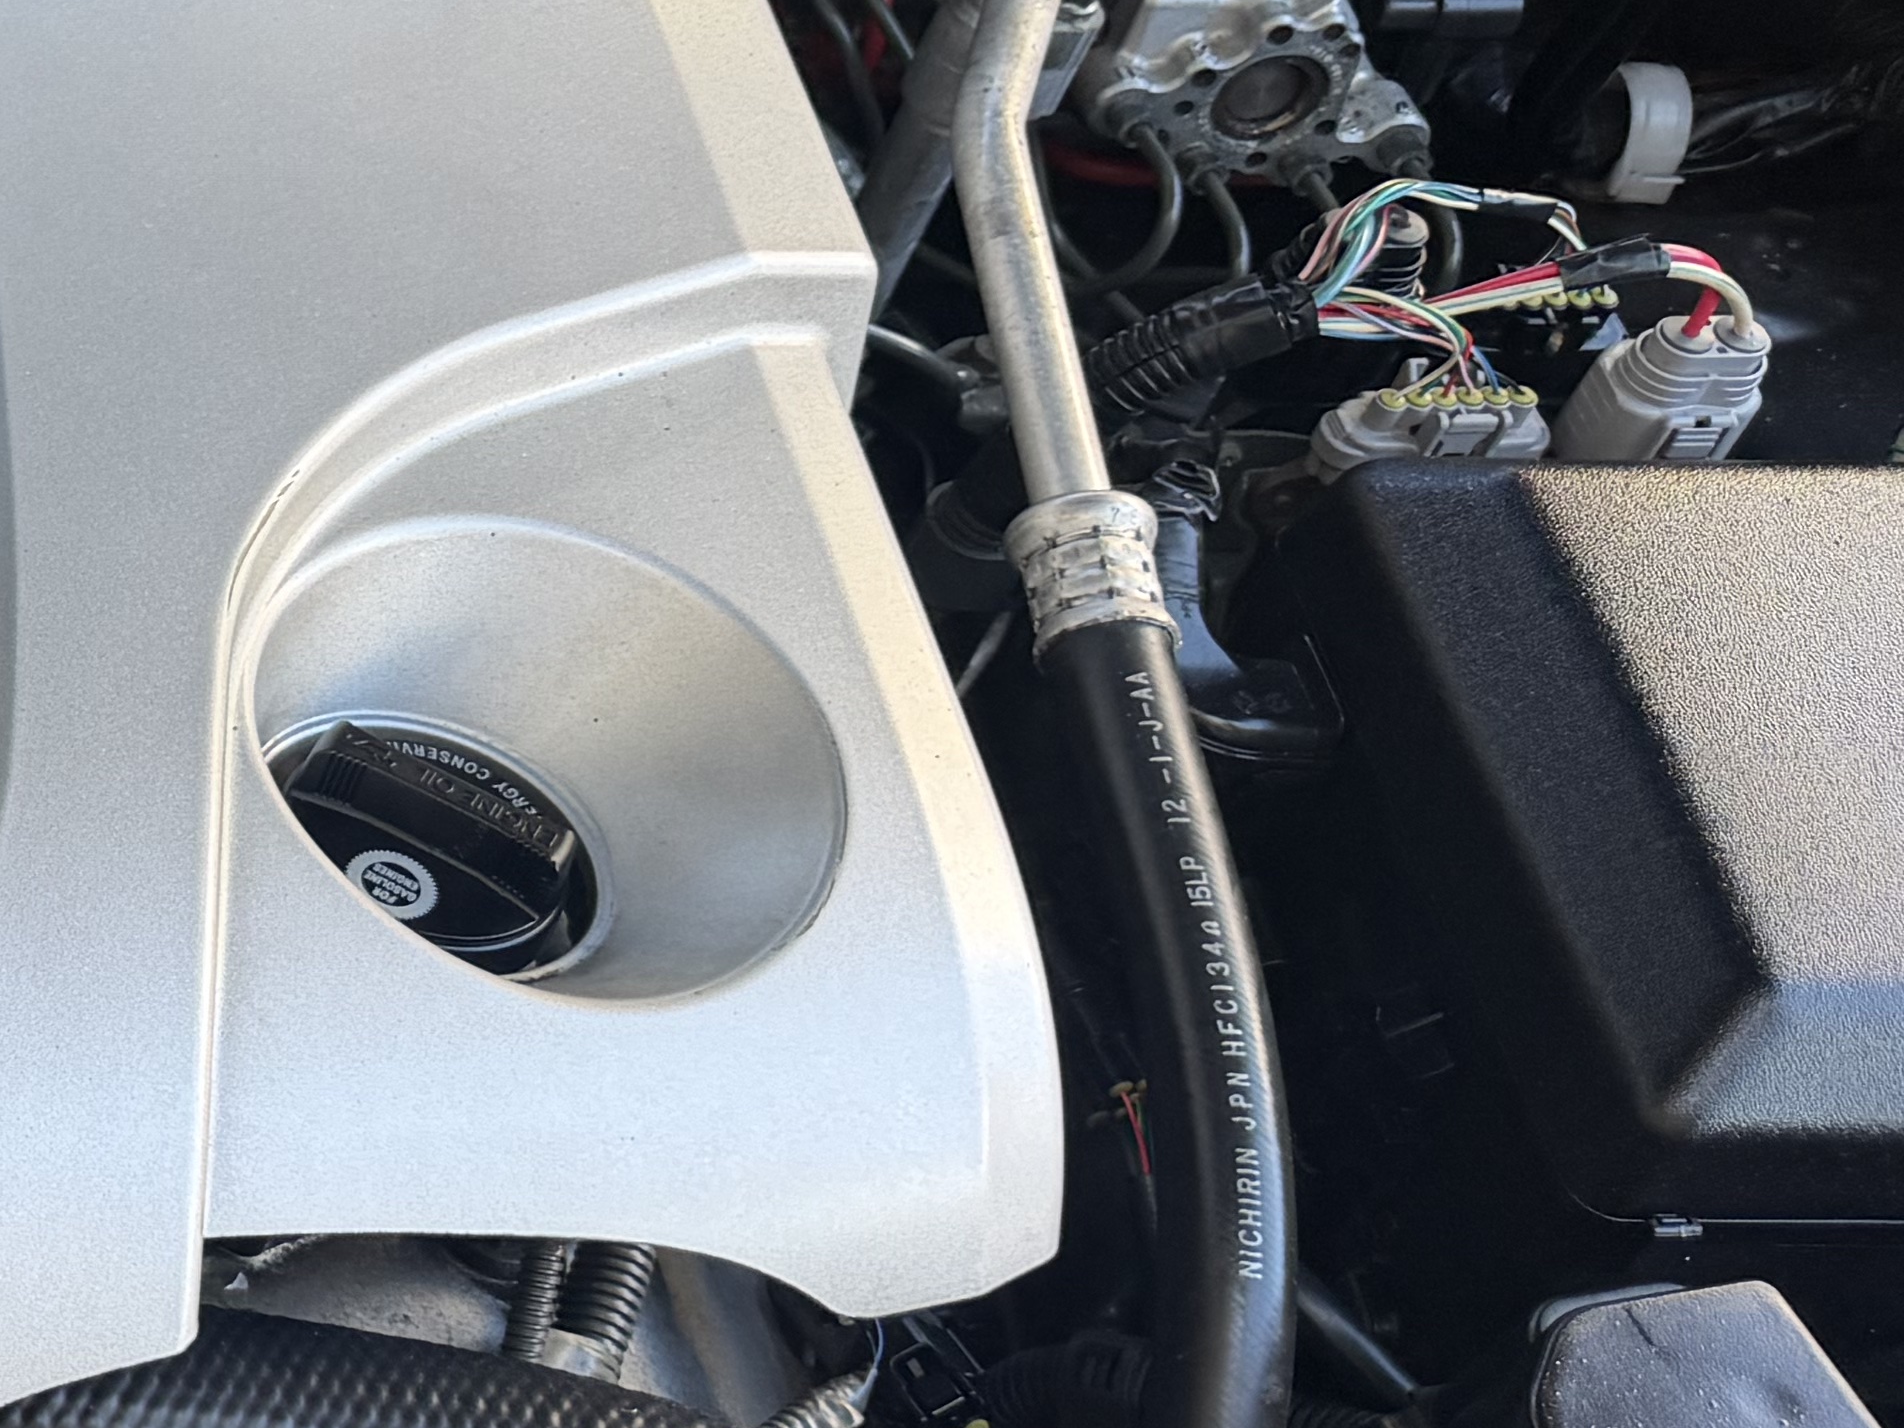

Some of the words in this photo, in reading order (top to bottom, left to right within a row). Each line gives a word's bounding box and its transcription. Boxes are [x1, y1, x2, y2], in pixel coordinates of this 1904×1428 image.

[372, 887, 398, 903] FOR
[1226, 1071, 1257, 1131] JPN
[1234, 1148, 1264, 1279] NICHIRIN
